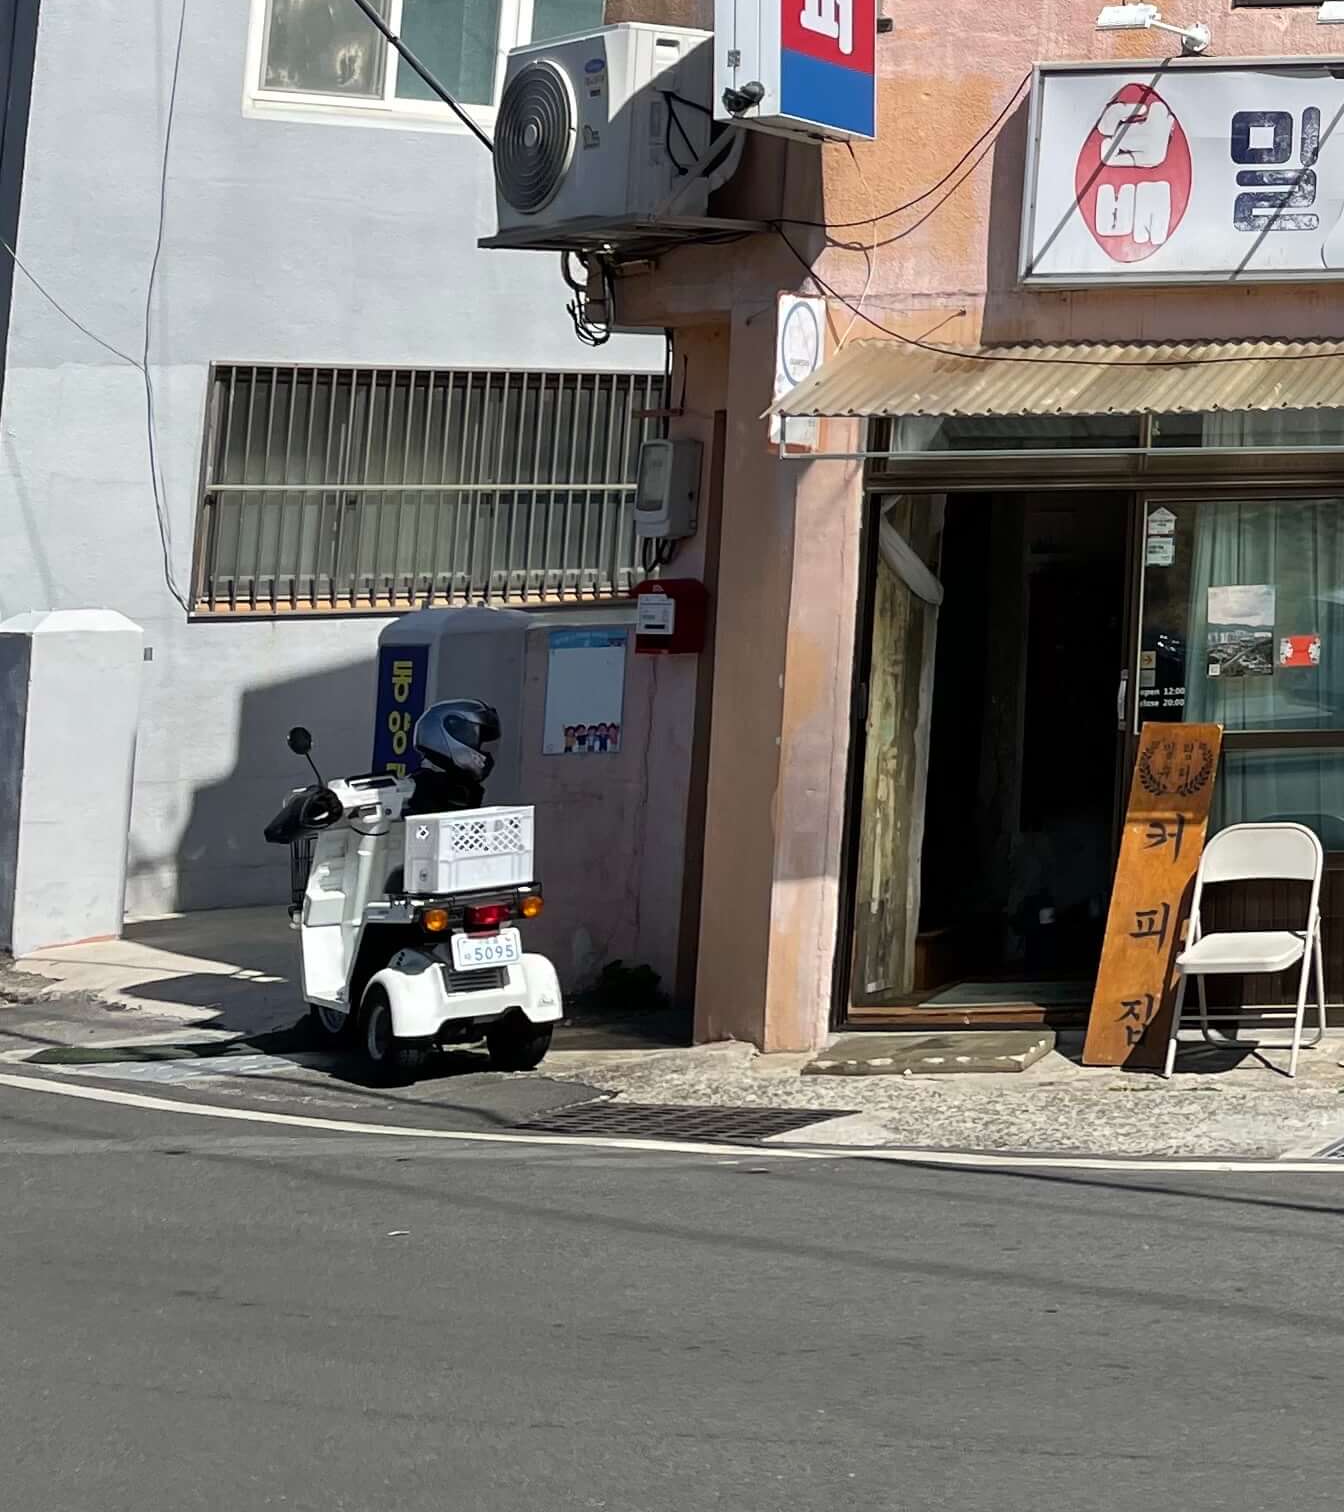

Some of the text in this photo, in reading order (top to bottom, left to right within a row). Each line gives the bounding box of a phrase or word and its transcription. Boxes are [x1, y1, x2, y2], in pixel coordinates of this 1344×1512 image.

[1164, 687, 1185, 696] 12:00
[1163, 698, 1185, 707] 20:00
[1113, 811, 1186, 1047] 커피집
[474, 944, 514, 961] 5095
